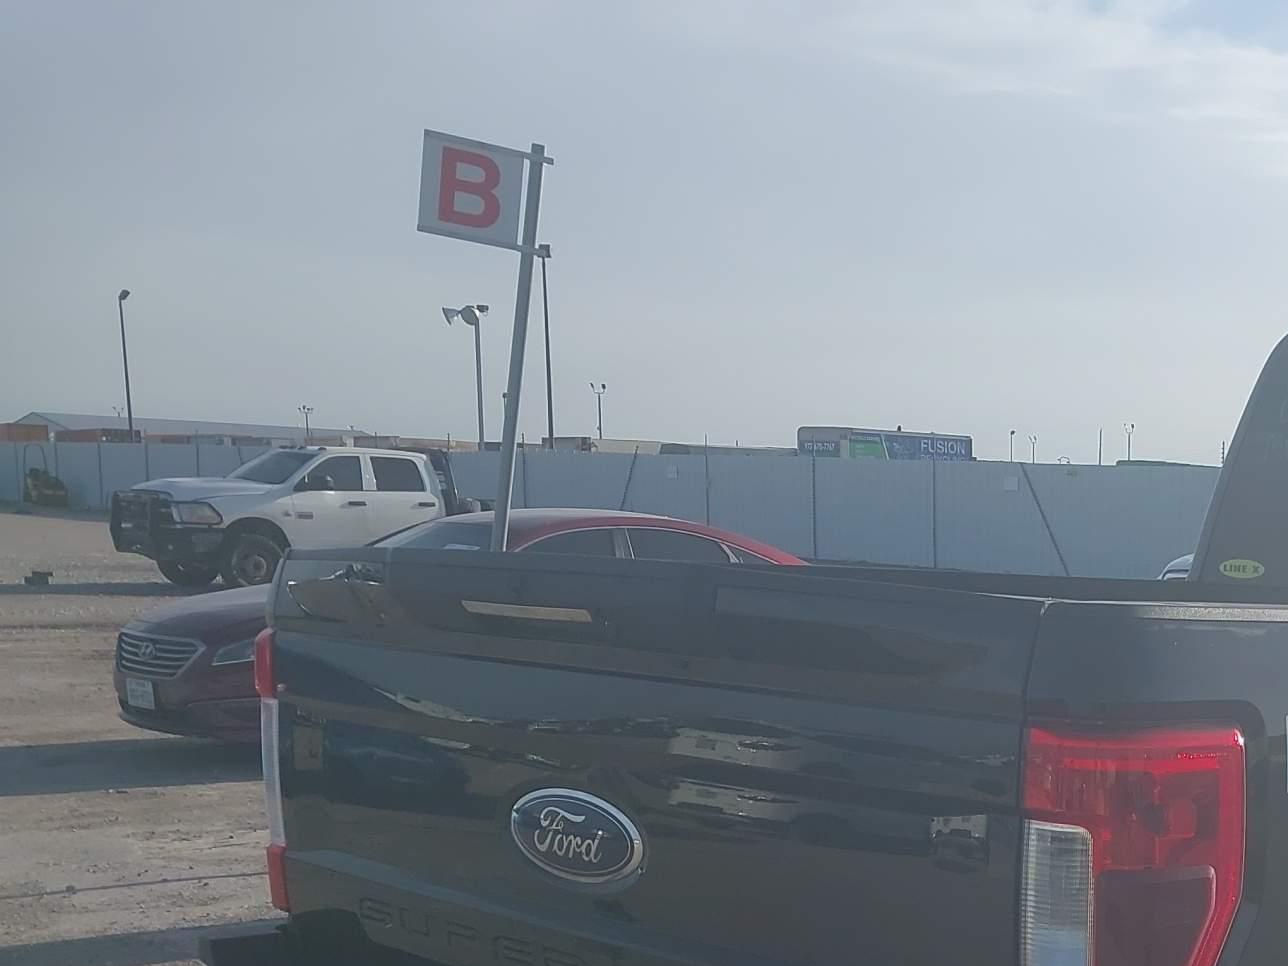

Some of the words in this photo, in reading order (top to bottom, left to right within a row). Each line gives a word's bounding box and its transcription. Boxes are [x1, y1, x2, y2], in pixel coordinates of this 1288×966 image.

[438, 145, 501, 228] B
[920, 439, 966, 454] FUSION
[534, 807, 602, 863] Ford
